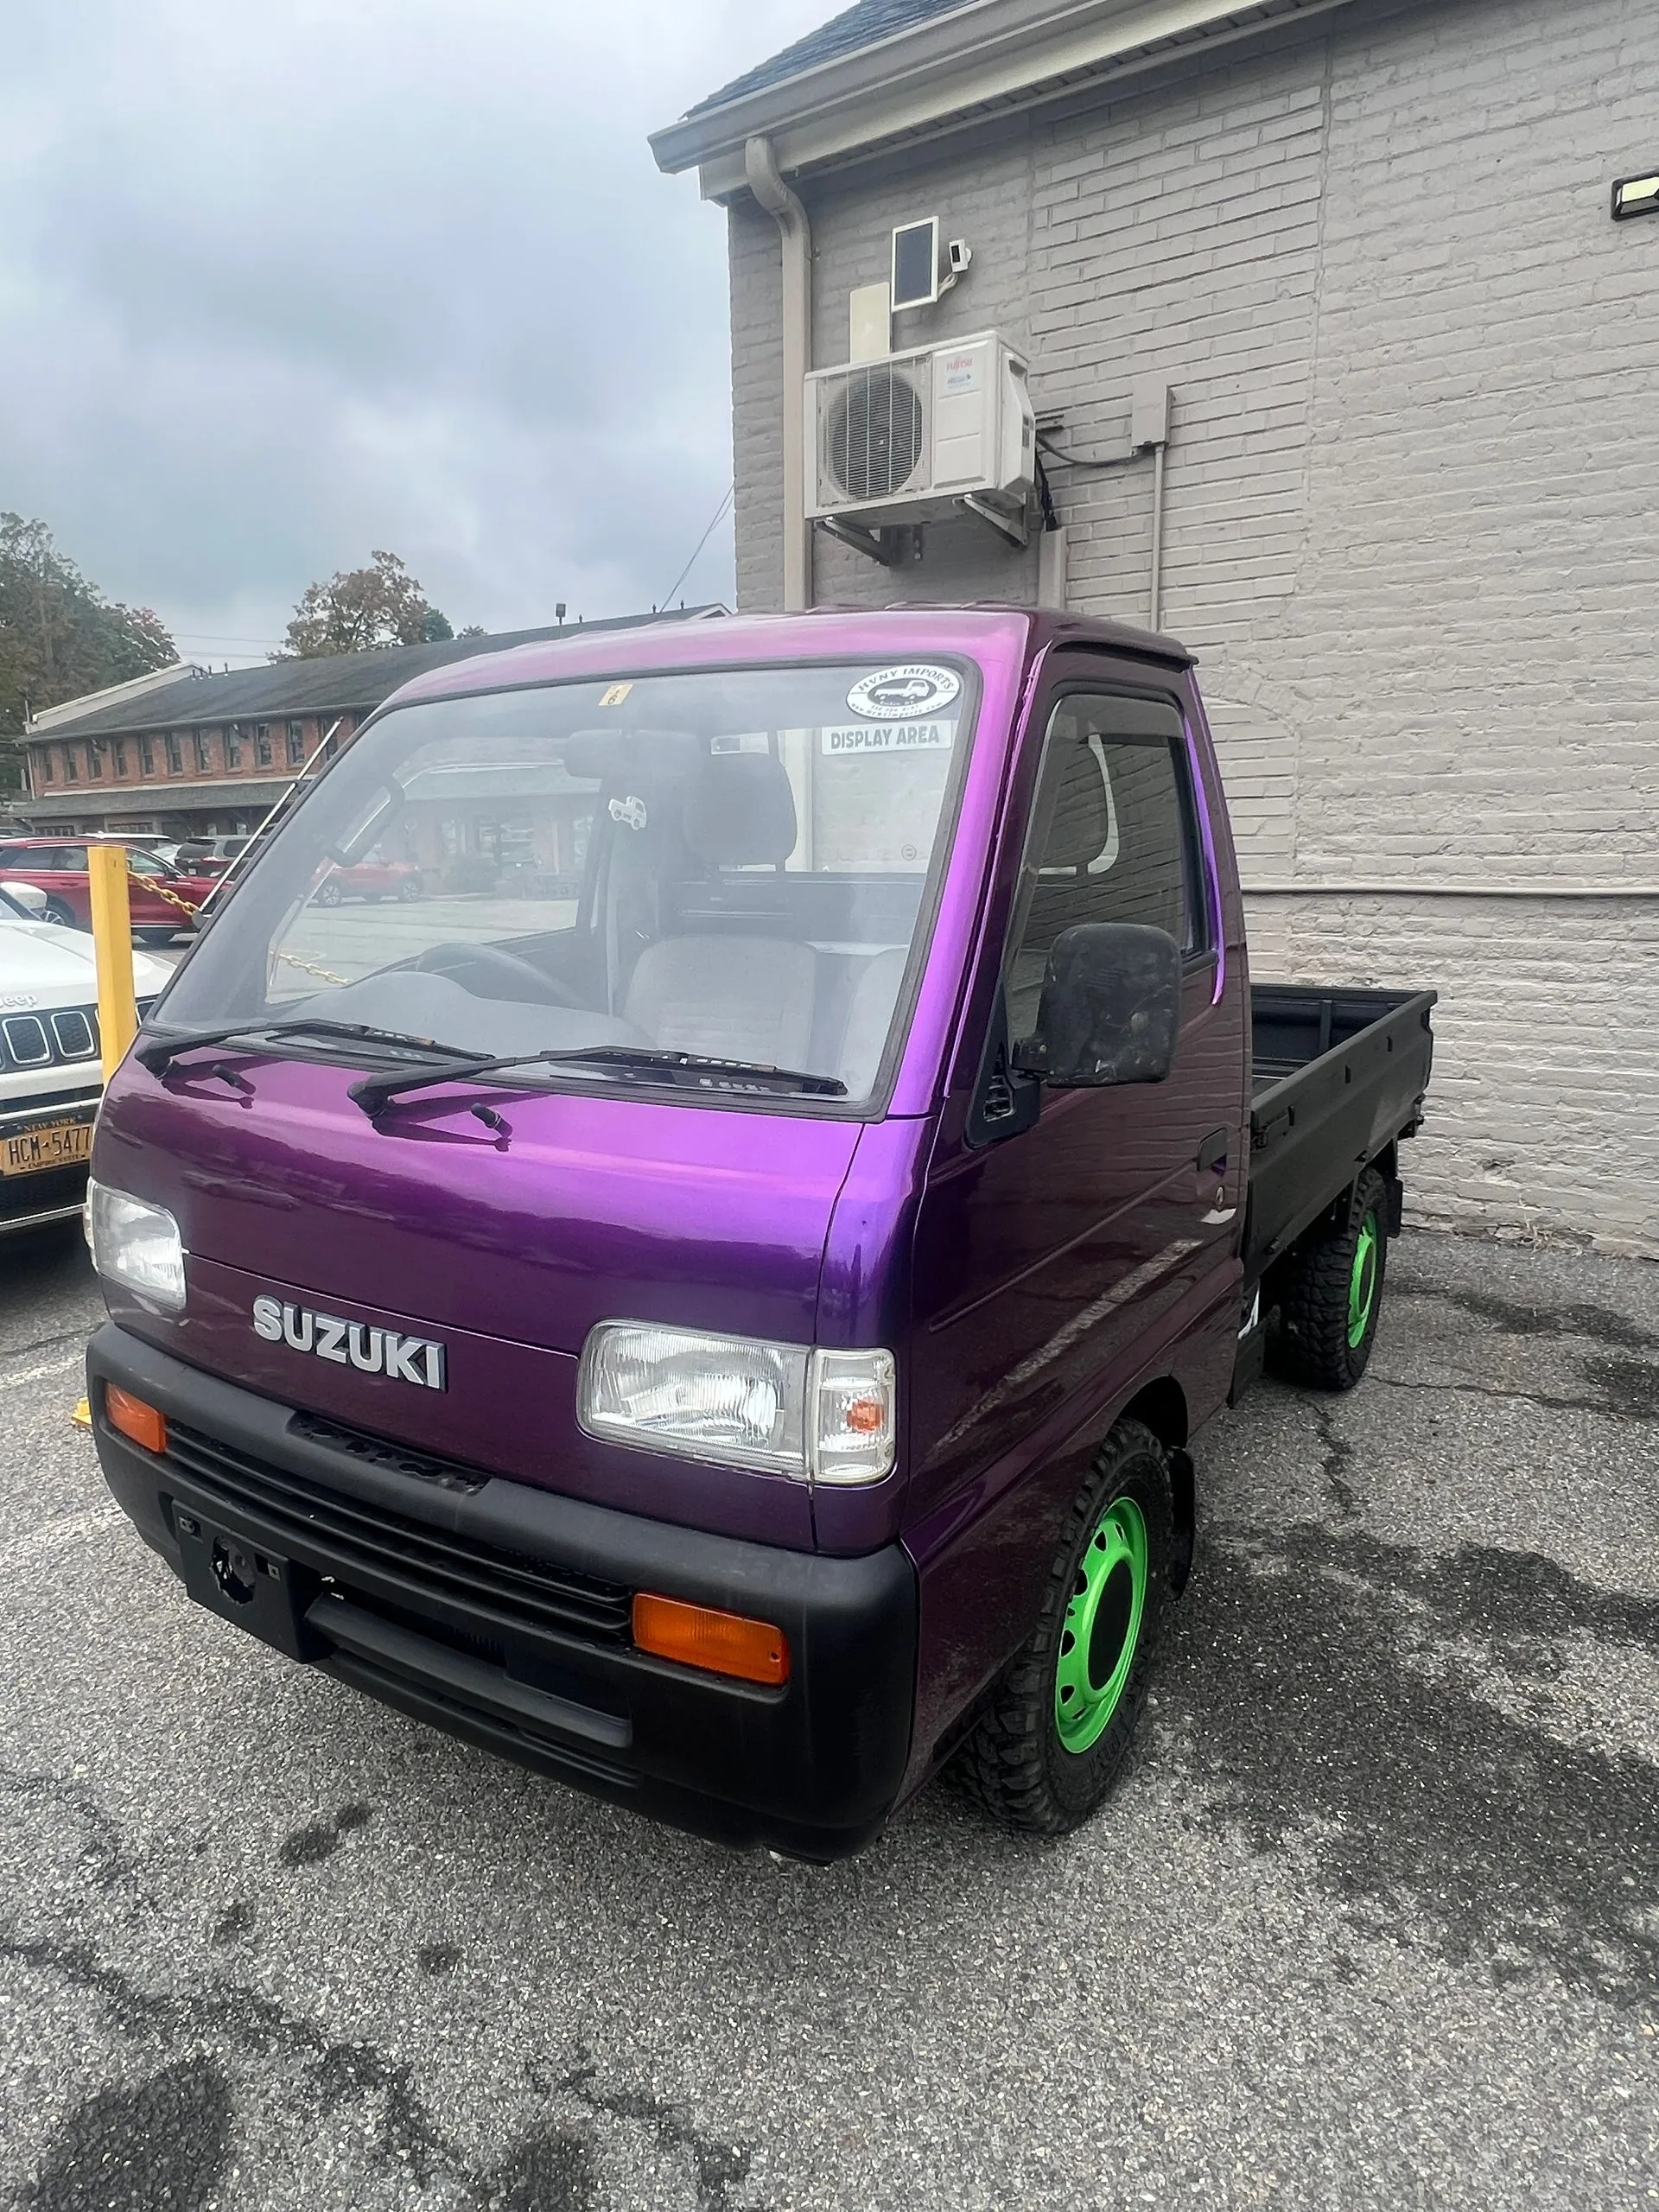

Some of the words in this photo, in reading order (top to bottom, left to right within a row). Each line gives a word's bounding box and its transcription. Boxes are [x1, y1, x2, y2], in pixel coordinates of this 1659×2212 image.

[903, 667, 954, 690] IMPORTS
[830, 728, 893, 750] DISPLAY
[896, 725, 940, 745] AREA
[252, 1294, 447, 1393] SUZUKI
